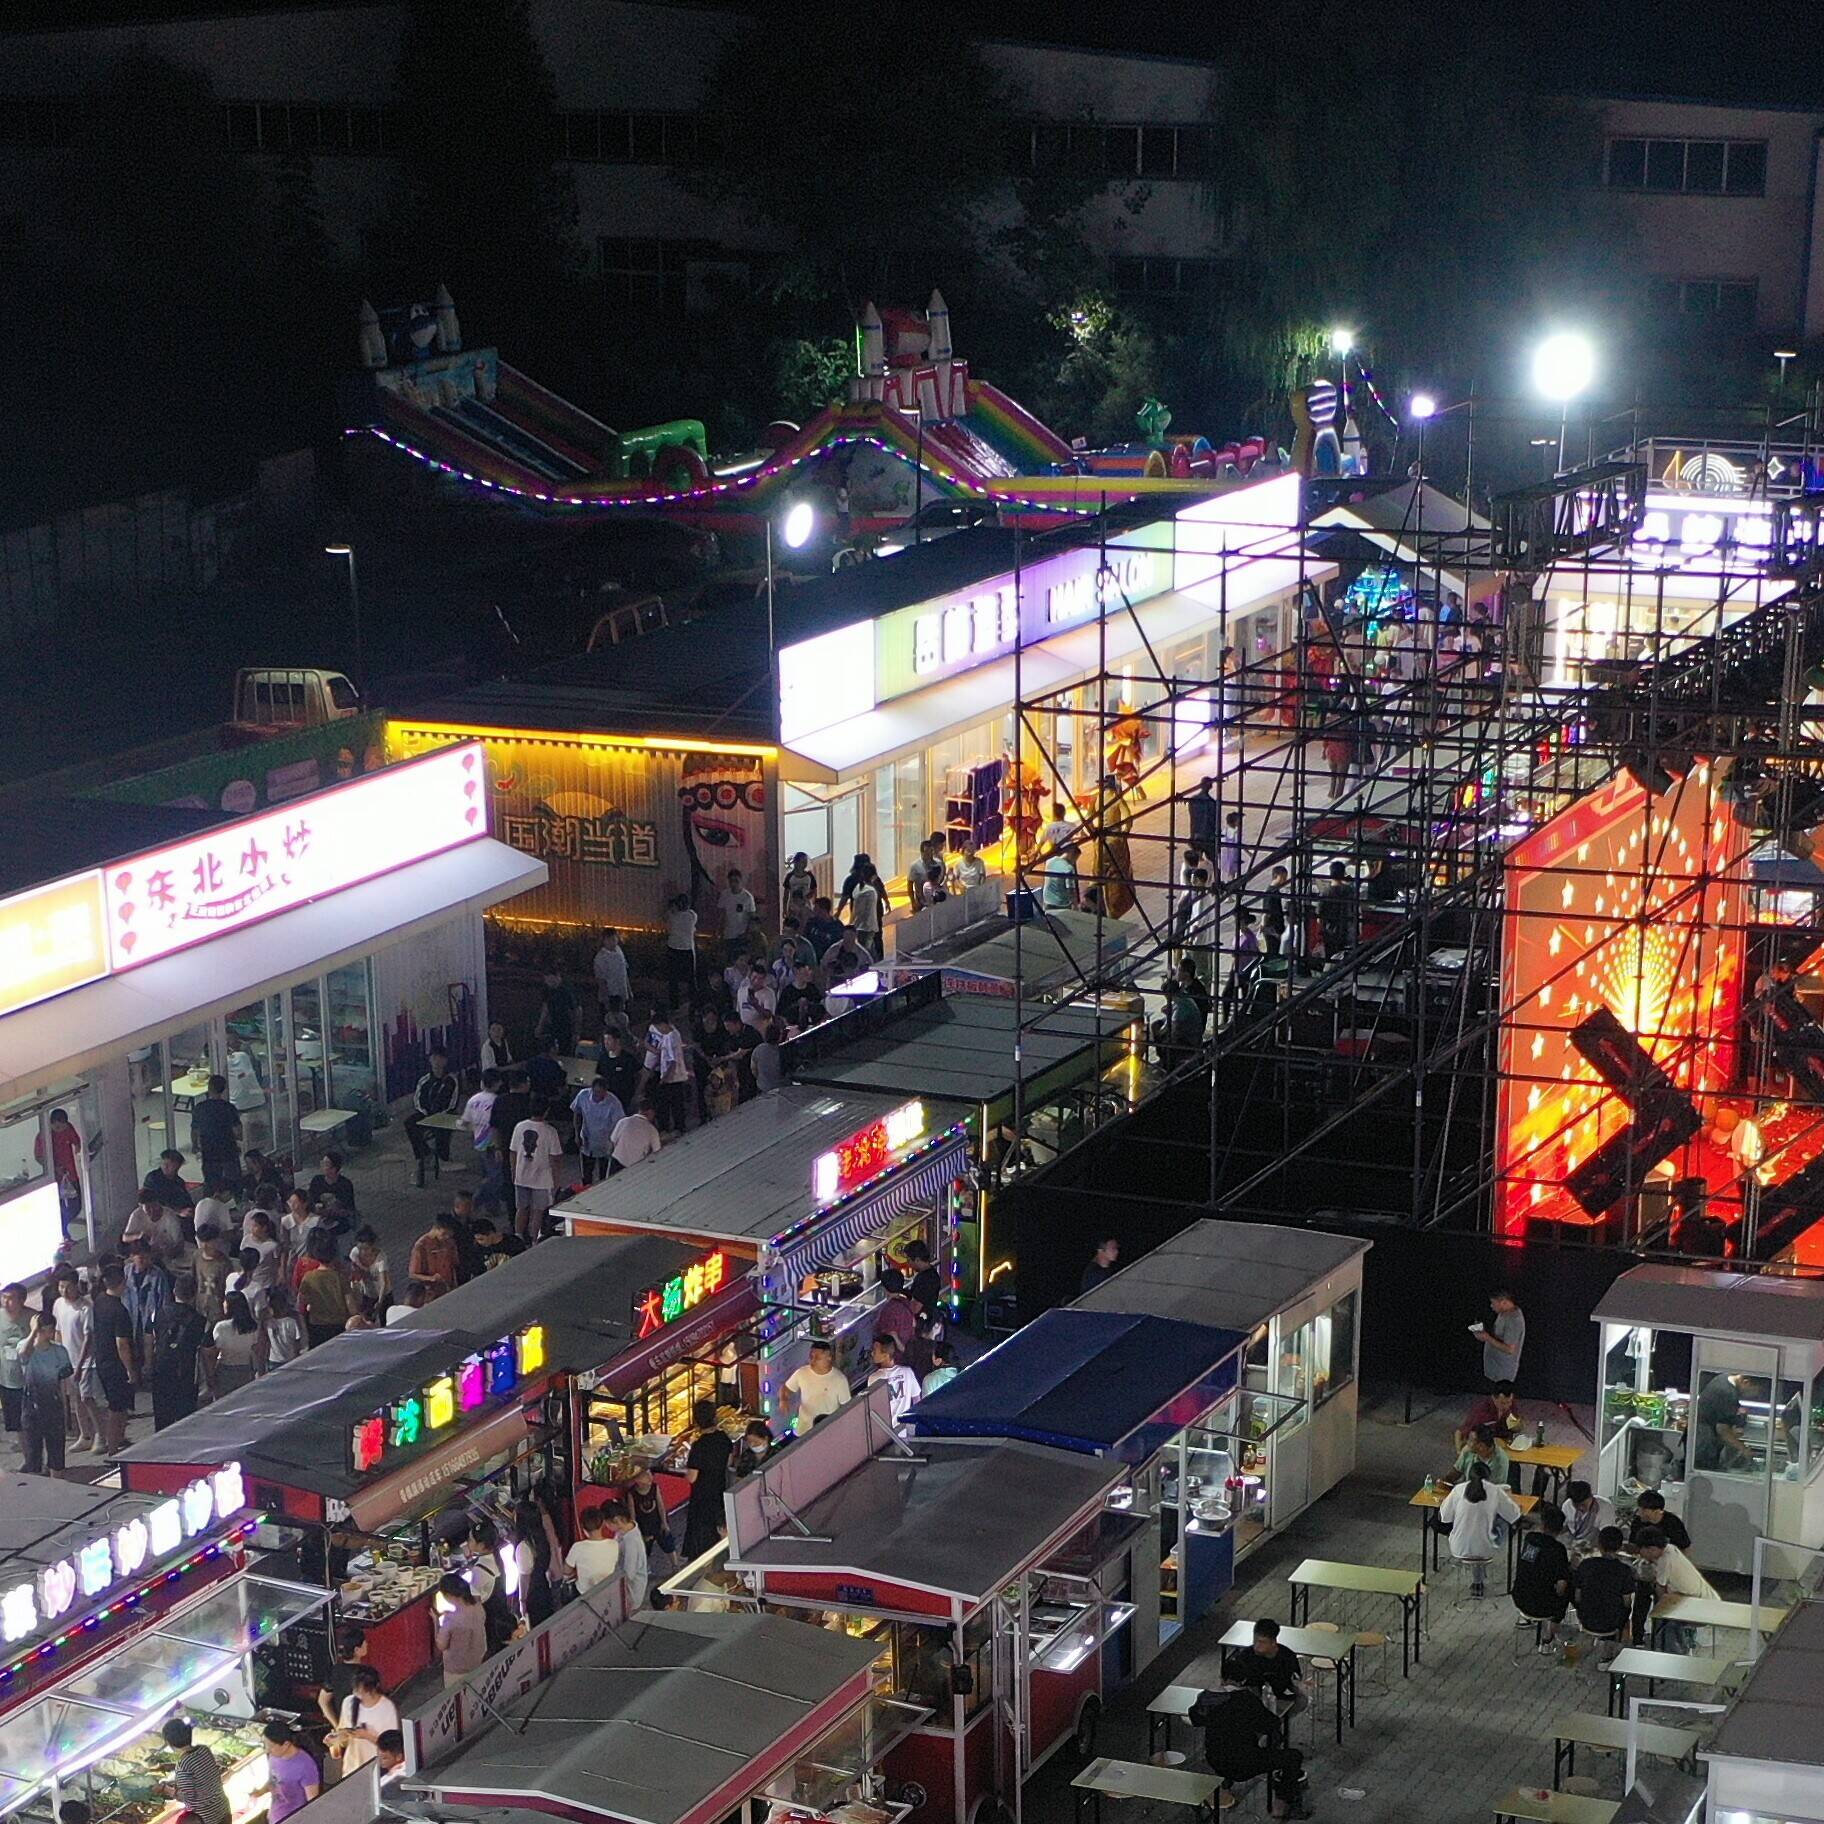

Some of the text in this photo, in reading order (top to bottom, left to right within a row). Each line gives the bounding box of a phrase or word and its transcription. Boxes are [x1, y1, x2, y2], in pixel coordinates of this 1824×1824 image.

[146, 819, 312, 911] 东北小炒
[503, 815, 660, 868] 国潮当道
